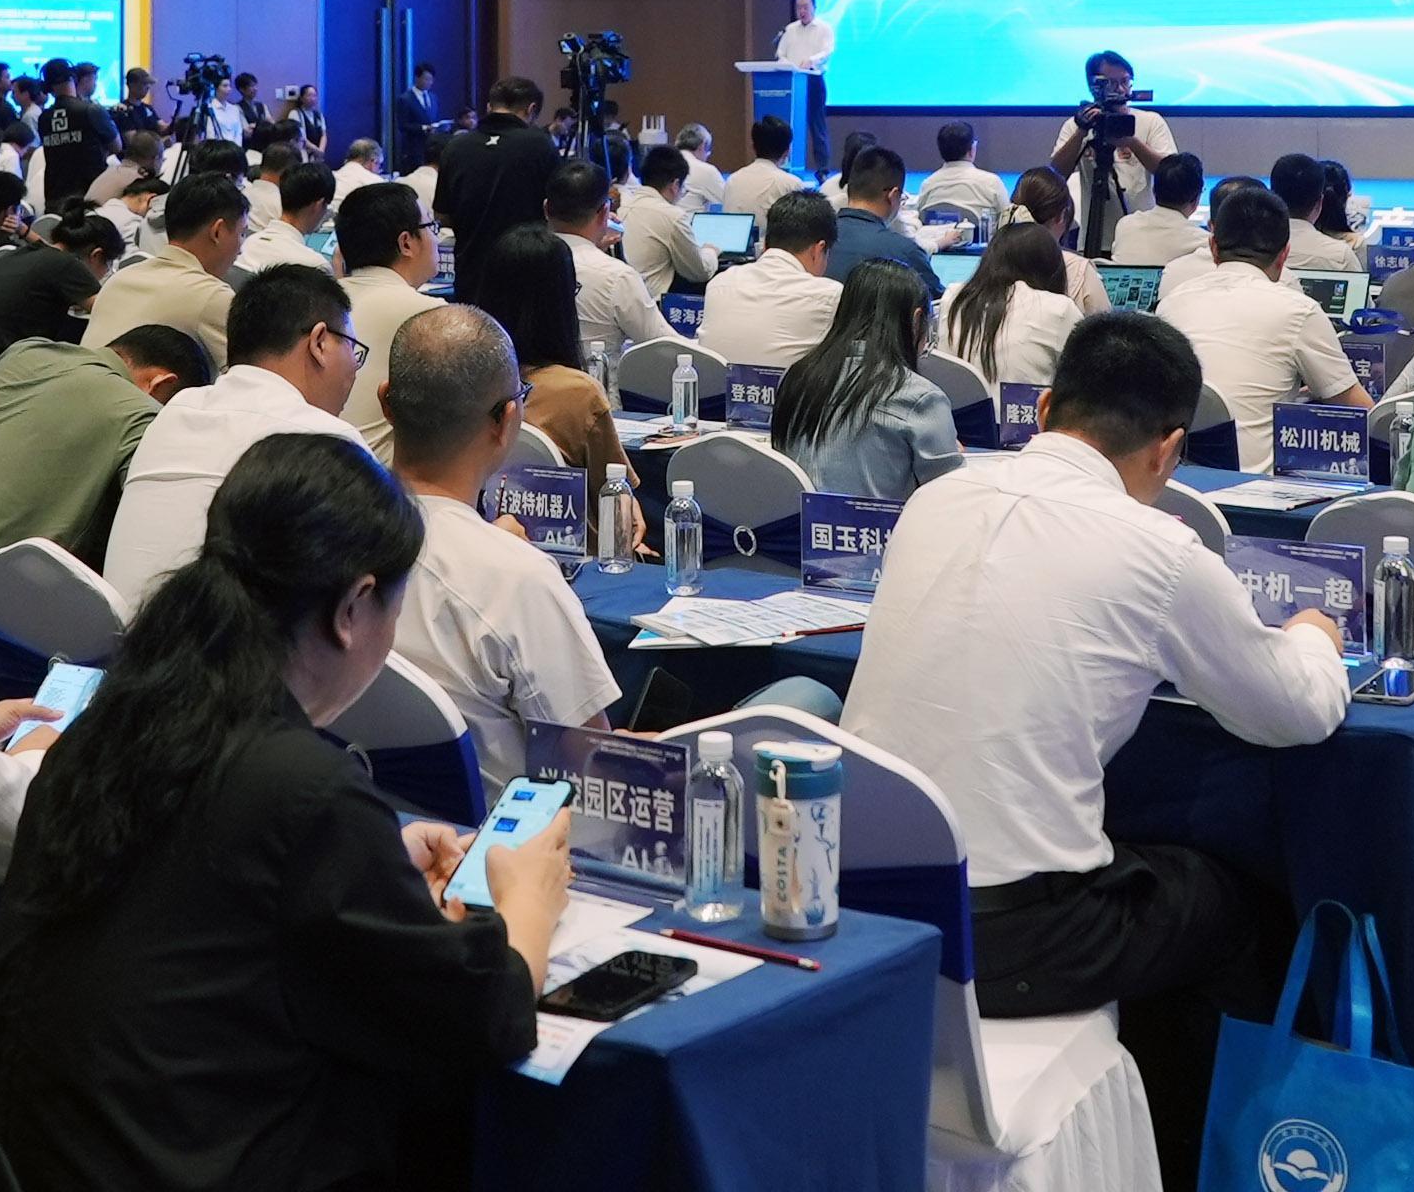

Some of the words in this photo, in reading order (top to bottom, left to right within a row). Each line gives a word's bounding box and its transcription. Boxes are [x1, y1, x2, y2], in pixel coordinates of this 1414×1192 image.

[1006, 403, 1038, 425] 隆深
[1279, 425, 1361, 454] 松川机械
[1237, 568, 1354, 610] 中机一超
[539, 765, 675, 834] 控园区运营
